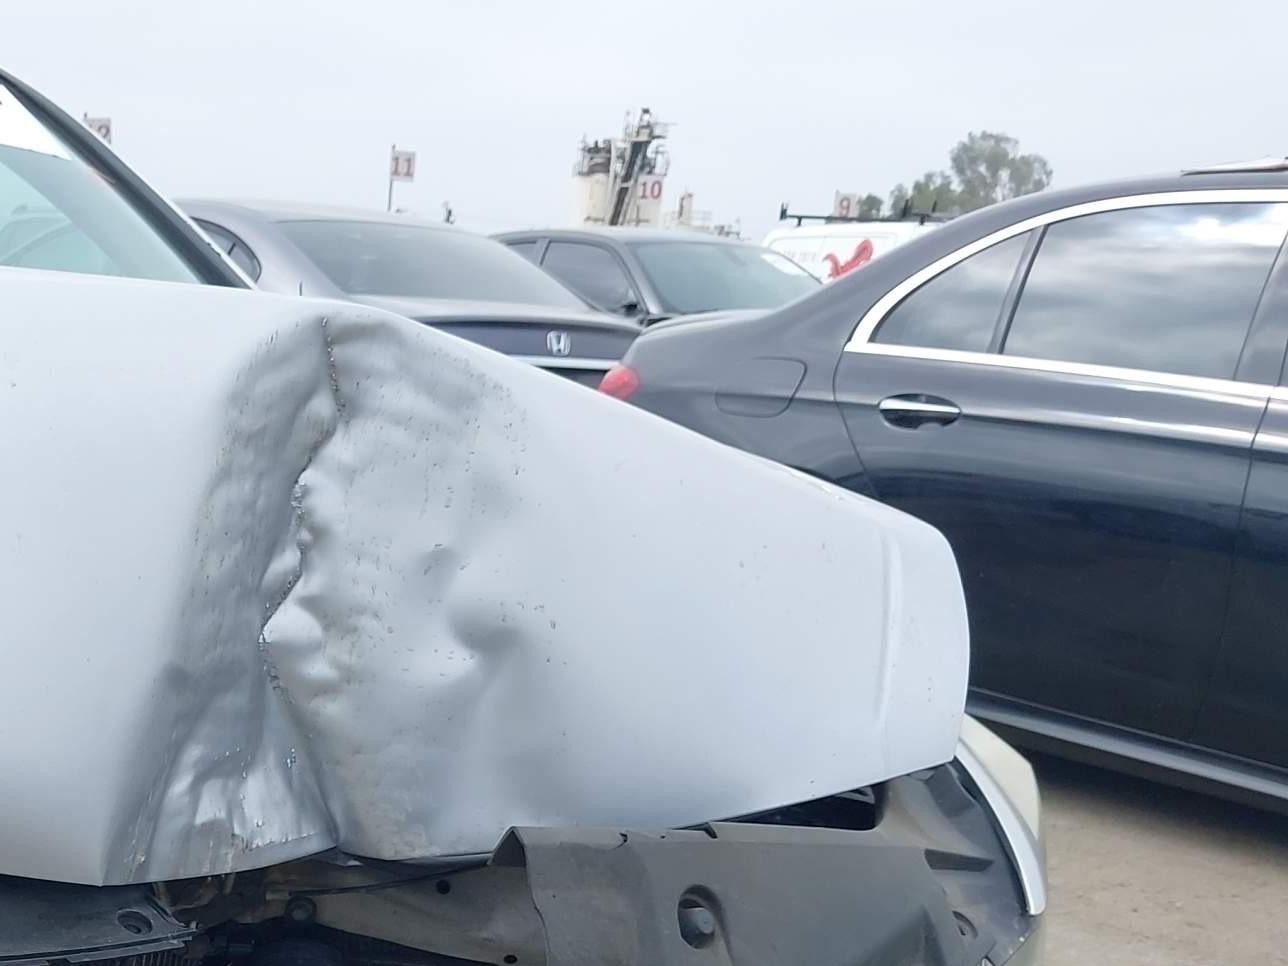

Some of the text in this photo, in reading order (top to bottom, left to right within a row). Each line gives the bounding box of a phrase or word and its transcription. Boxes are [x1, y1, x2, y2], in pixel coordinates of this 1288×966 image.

[391, 156, 414, 177] 11
[639, 180, 663, 200] 10
[839, 196, 851, 218] 9
